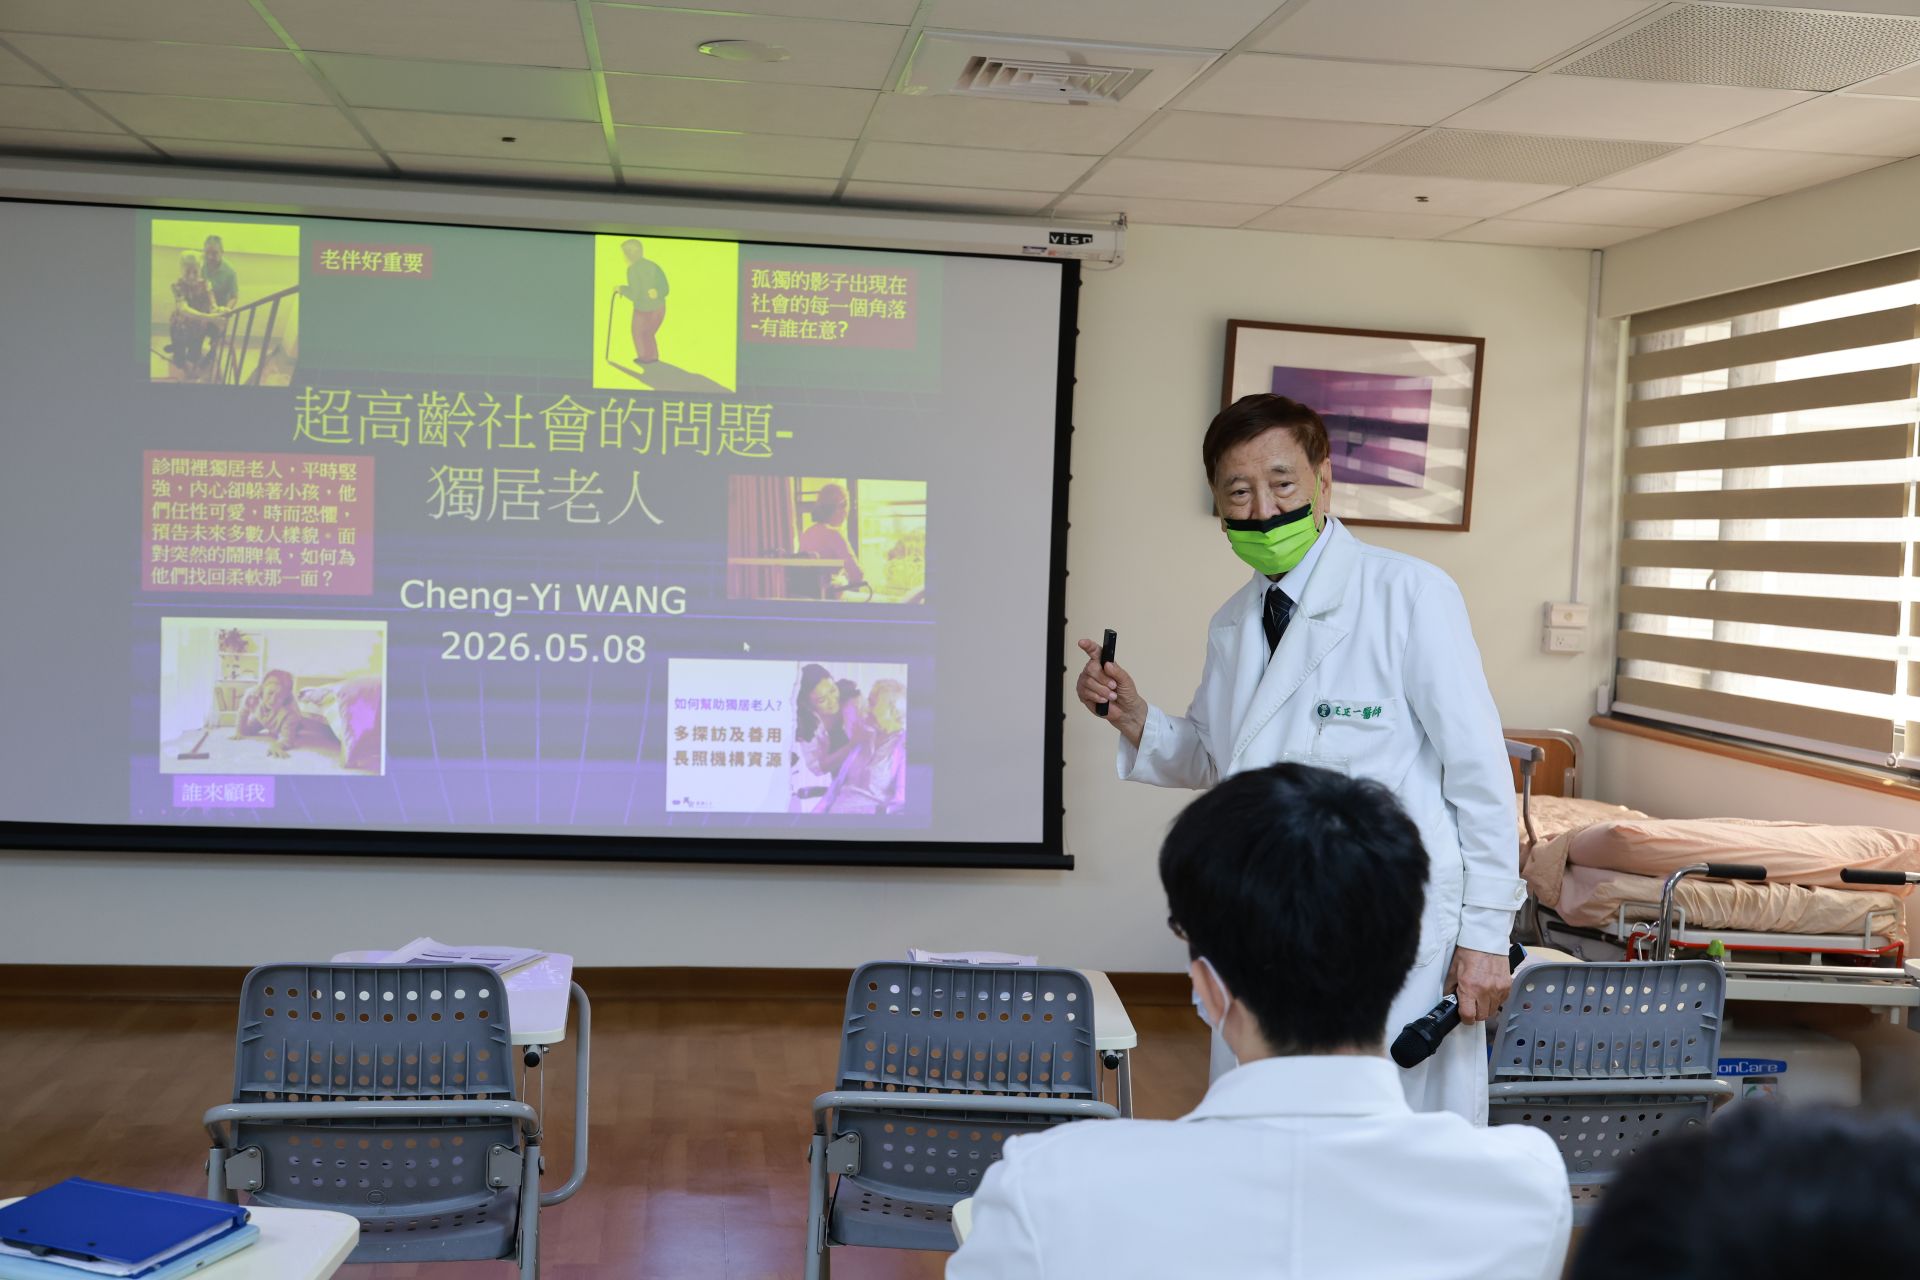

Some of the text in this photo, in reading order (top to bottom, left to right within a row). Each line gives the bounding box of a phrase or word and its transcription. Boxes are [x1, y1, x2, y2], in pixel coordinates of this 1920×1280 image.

[320, 249, 423, 274] 老伴好重要
[751, 268, 908, 296] 孤獨的影子出現在
[751, 293, 908, 319] 社會的每一個角落
[426, 464, 665, 526] 獨居老人
[400, 580, 687, 617] Cheng-Yi WANG
[441, 631, 647, 663] 2026.05.08
[674, 725, 782, 743] 多探訪及善用
[673, 750, 782, 767] 長照機構資源
[181, 782, 265, 802] 誰來顧我
